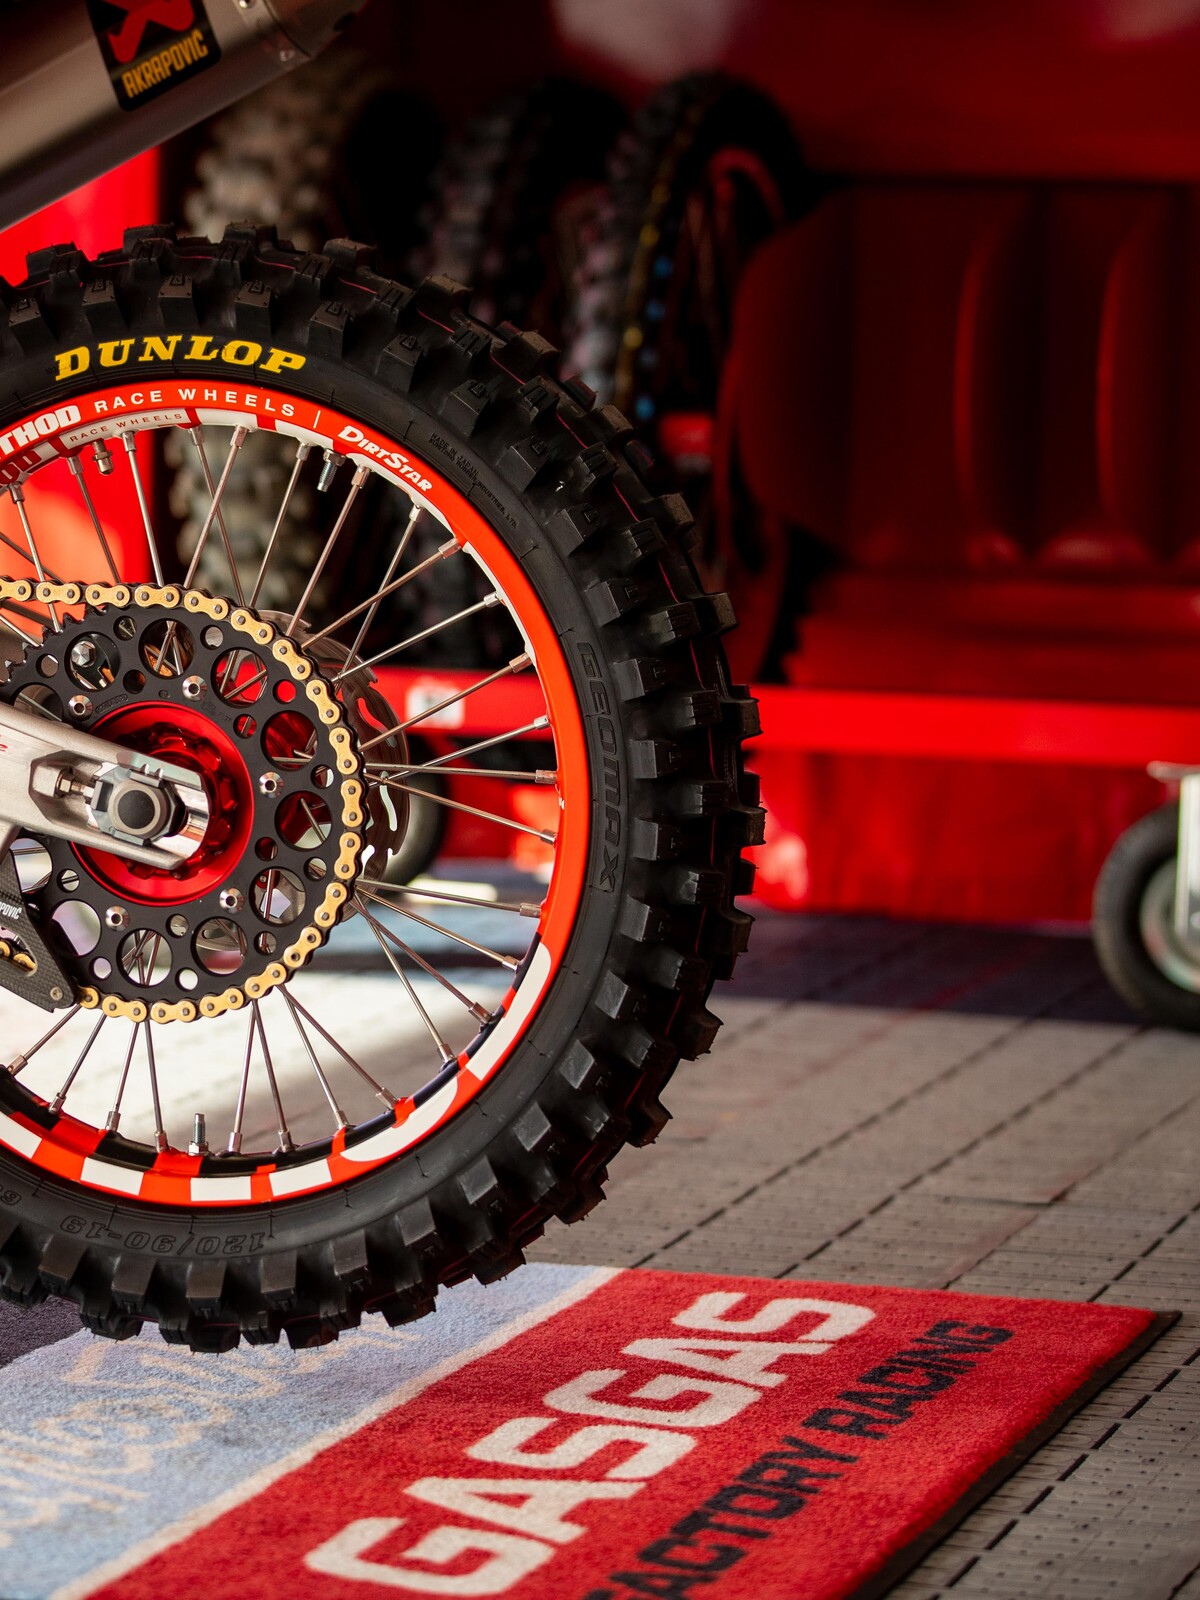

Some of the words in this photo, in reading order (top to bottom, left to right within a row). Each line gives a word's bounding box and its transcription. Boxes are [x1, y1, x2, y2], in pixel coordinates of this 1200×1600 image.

[55, 334, 308, 381] DUNLOP
[70, 426, 108, 442] RACE
[116, 413, 183, 428] WHEELS
[94, 390, 162, 413] RACE
[178, 388, 295, 417] WHEELS
[576, 642, 621, 892] GEOMAX
[304, 1290, 876, 1597] GASGAS
[583, 1435, 859, 1600] ACTORY
[801, 1320, 1014, 1440] RACING
